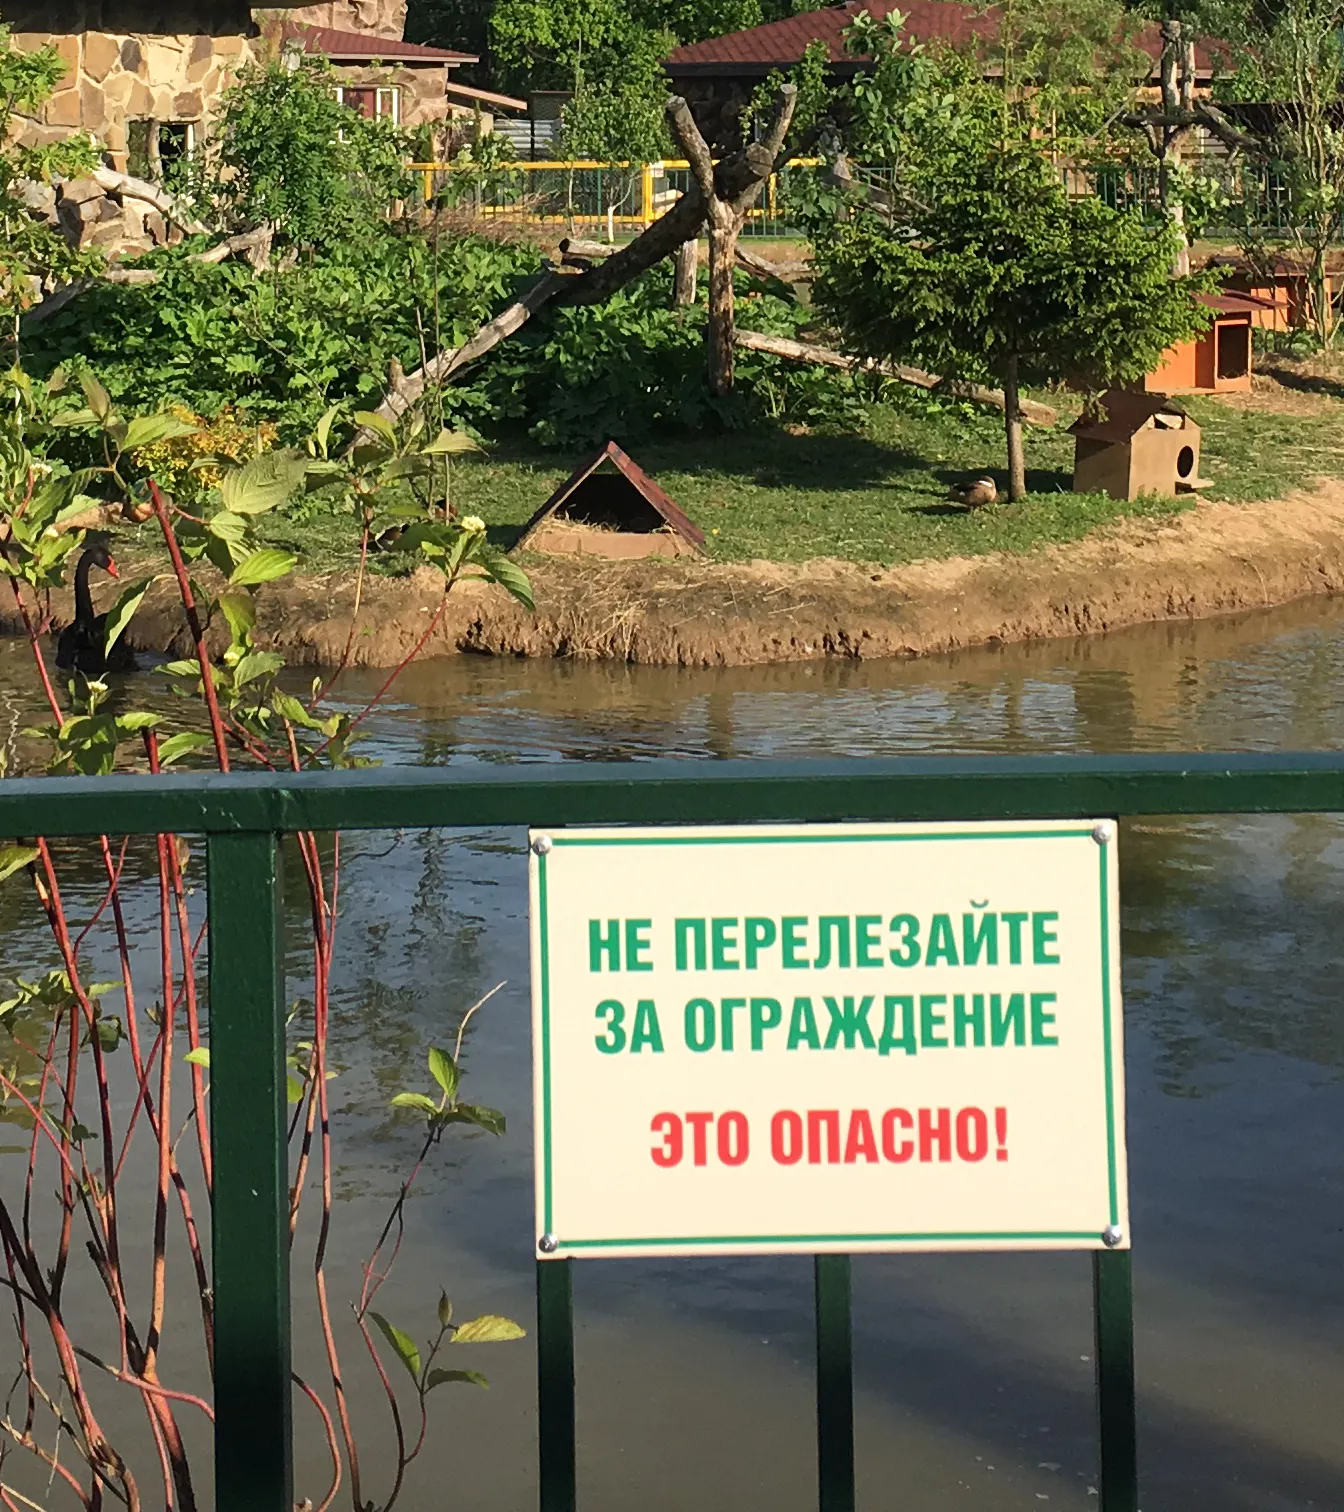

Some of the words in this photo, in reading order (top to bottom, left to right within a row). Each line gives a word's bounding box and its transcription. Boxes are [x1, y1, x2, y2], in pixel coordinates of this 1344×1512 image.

[588, 918, 653, 972] НЕ
[674, 899, 1060, 971] ПЕРЕЛЕЗАЙТЕ
[595, 999, 664, 1055] ЗА
[683, 992, 1058, 1056] ОГРАЖДЕНИЕ
[650, 1110, 750, 1168] ЭТО
[770, 1106, 1009, 1166] ОПАСНО!
